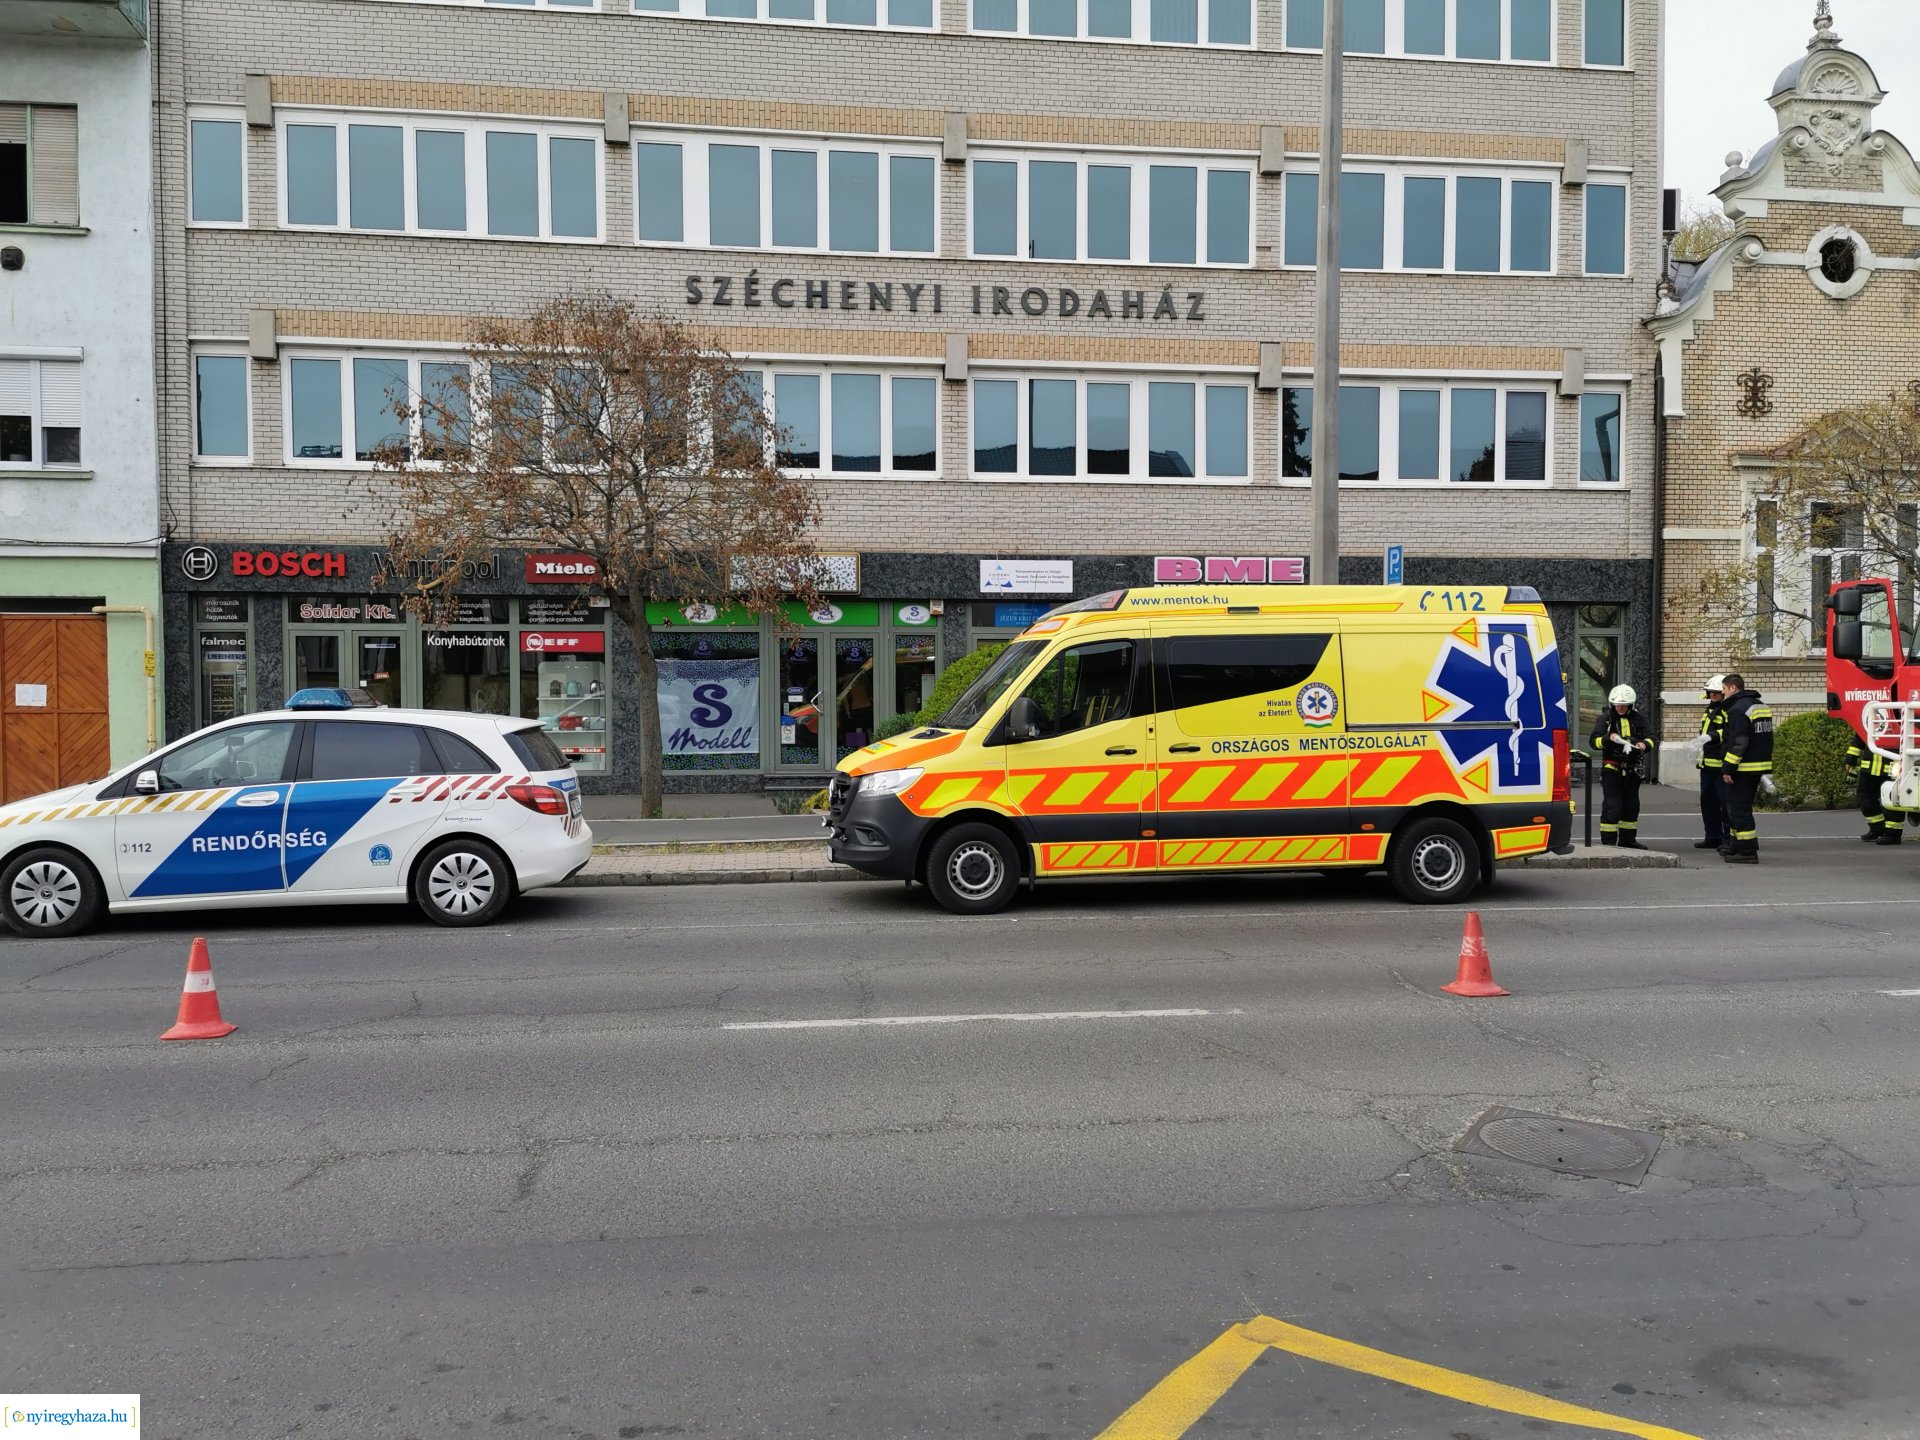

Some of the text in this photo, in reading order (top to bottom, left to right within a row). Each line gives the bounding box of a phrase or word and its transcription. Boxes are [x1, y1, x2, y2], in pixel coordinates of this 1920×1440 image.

[685, 269, 1206, 320] SZÉCHENYI IRODAHÁZ
[232, 551, 347, 577] BOSCH
[535, 562, 597, 575] Miele
[1154, 556, 1305, 584] BME
[1389, 548, 1400, 575] P
[1130, 594, 1229, 606] www.mentok.hu
[1441, 591, 1486, 611] 112
[300, 604, 397, 620] Solidor Kft.
[910, 606, 920, 617] S
[201, 637, 246, 646] falmec
[427, 634, 506, 649] Konyhabútorok
[690, 684, 733, 728] S
[1267, 699, 1292, 707] Hivatás
[668, 726, 753, 751] Modell
[1211, 732, 1428, 754] ORSZÁGOS MENTŐSZOLGÁLAT
[131, 843, 152, 853] 112
[192, 828, 327, 853] RENDŐRSÉG
